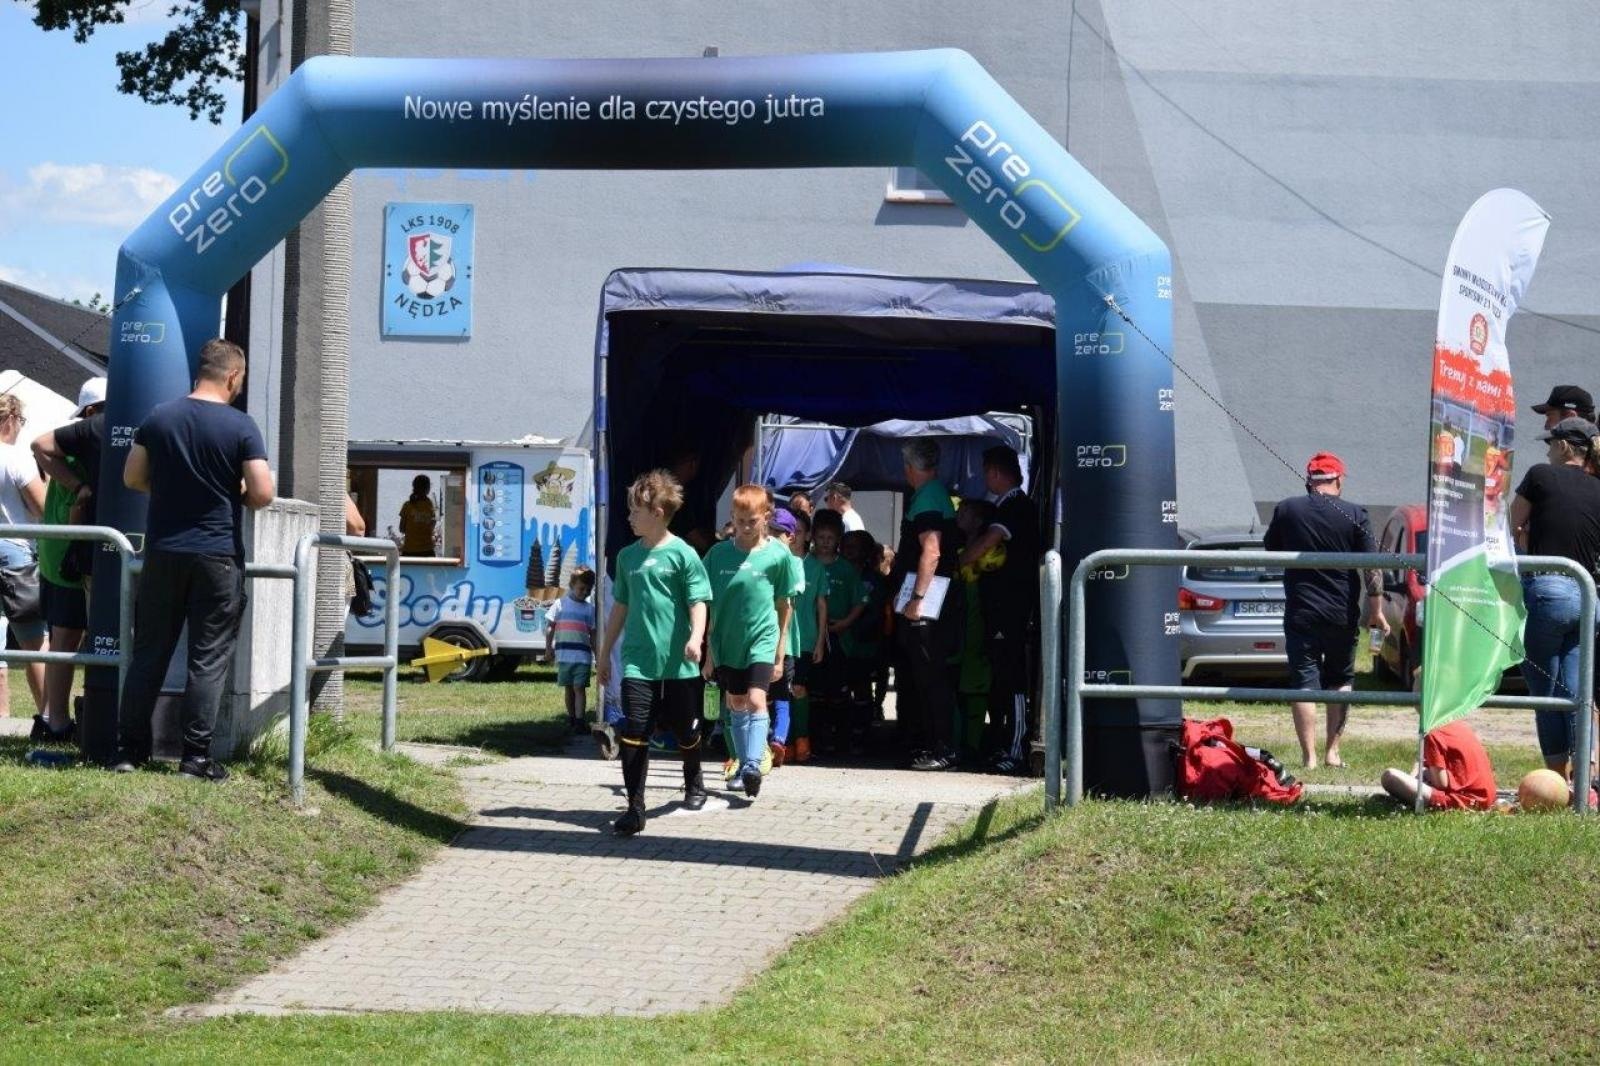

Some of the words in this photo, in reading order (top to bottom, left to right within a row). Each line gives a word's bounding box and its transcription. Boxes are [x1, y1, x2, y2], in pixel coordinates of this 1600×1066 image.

[404, 96, 472, 120] Nowe
[481, 94, 591, 126] myślenie
[599, 95, 635, 120] dla
[645, 96, 756, 125] czystego
[764, 94, 825, 124] jutra
[961, 120, 1030, 182] pre
[945, 145, 1026, 230] zero
[169, 171, 225, 235] pre
[185, 175, 267, 254] zero
[400, 215, 425, 233] LKS
[428, 216, 460, 234] 1908
[394, 293, 463, 319] NĘDZA
[121, 321, 143, 331] pre
[121, 333, 151, 343] zero
[1075, 332, 1100, 345] pre
[1075, 345, 1110, 354] zero
[1077, 445, 1101, 457] pre
[1078, 457, 1112, 467] zero
[1162, 513, 1178, 522] zer
[1088, 570, 1115, 580] ero
[1241, 602, 1263, 614] SRC
[94, 635, 114, 646] pre
